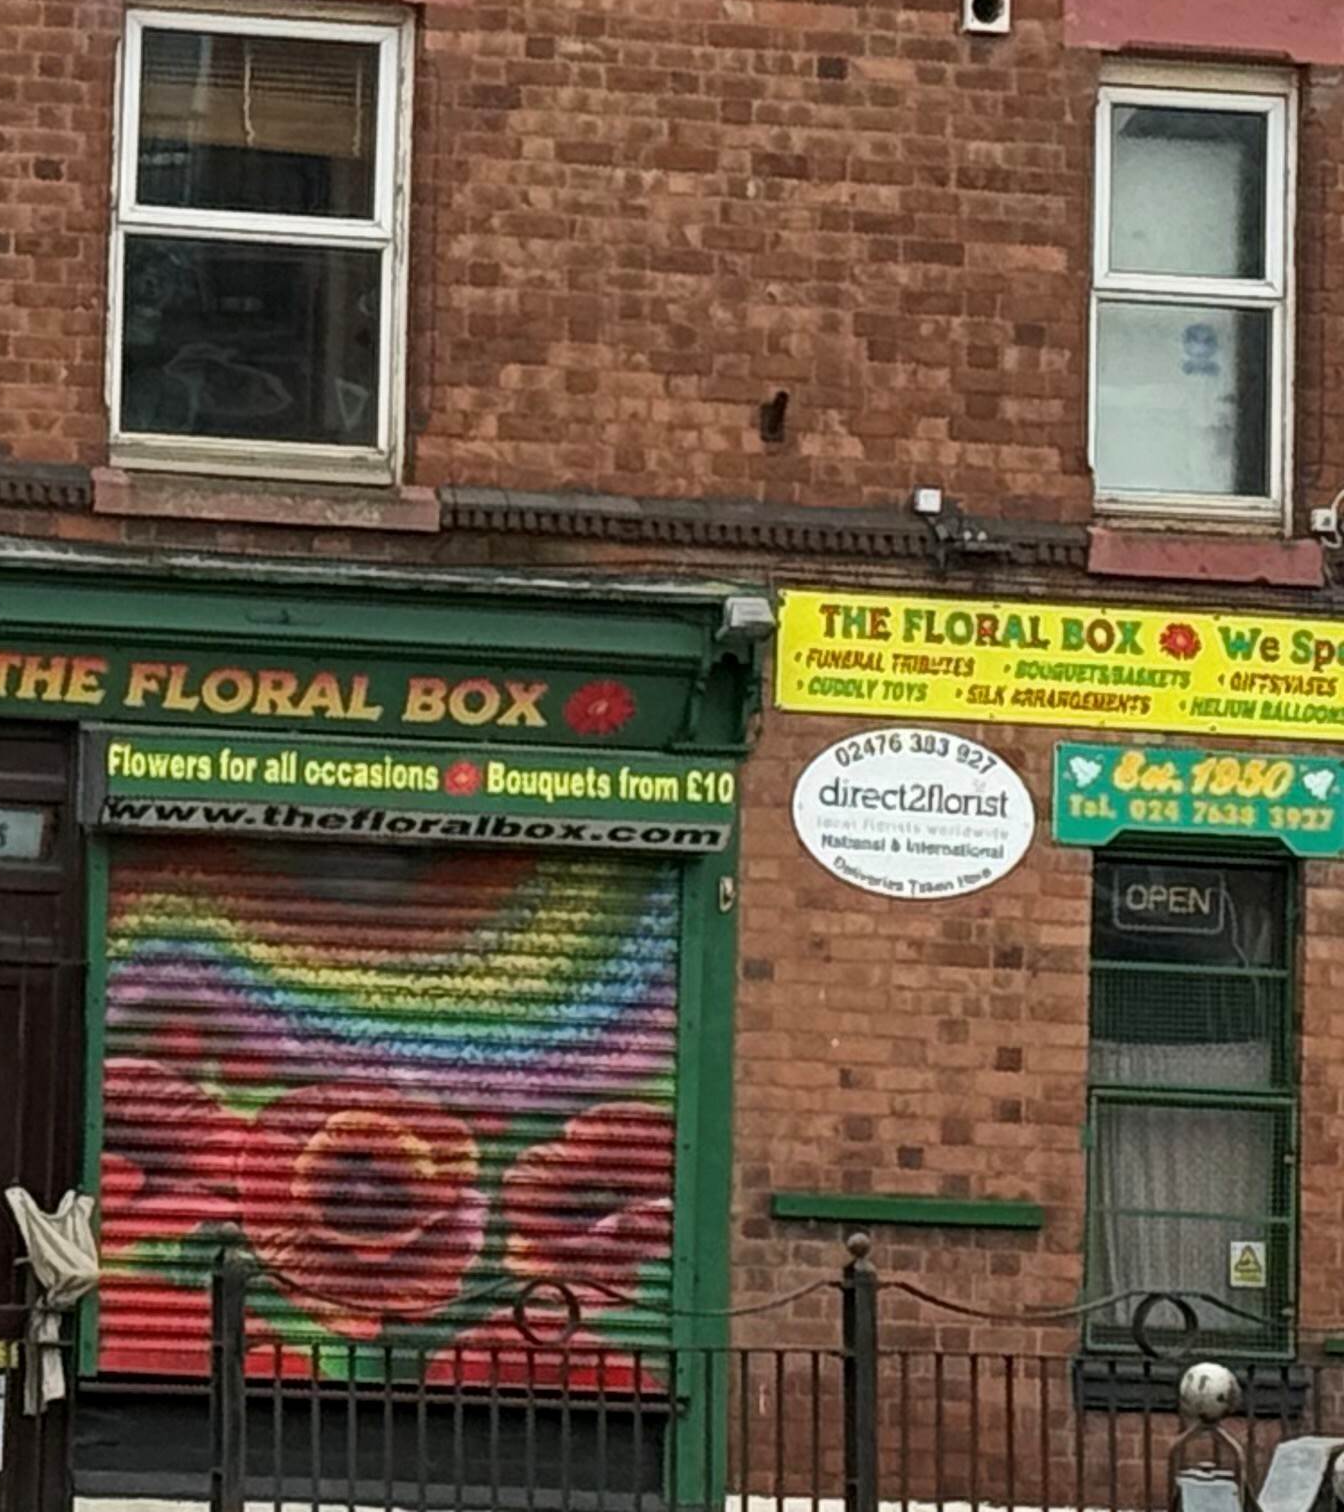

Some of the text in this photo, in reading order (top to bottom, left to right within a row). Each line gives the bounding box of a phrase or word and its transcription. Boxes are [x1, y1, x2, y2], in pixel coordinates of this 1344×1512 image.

[819, 604, 892, 641] THE
[902, 608, 1050, 649] FLORAL
[1061, 618, 1144, 655] BOX
[1218, 626, 1280, 662] We
[806, 648, 885, 673] FUNERAL
[892, 653, 975, 677] TRIBUTES
[123, 662, 383, 720] FLORAL
[402, 678, 548, 727] BOX
[808, 676, 879, 700] CUDDLY
[882, 680, 928, 702] TOYS
[966, 684, 1007, 706] SILK
[1011, 688, 1151, 714] ARRANGEMENTS
[1190, 696, 1257, 719] HELIUM
[108, 743, 735, 803] Flowers for all occasions Bouquets from £10
[835, 733, 997, 774] 02476 383 927
[818, 776, 1009, 818] direct2florist
[1191, 757, 1294, 799] 1950
[105, 797, 723, 847] www.thefloralbox.com
[1069, 794, 1117, 819] Tel.
[1129, 798, 1179, 824] 024
[822, 834, 885, 852] National
[907, 838, 1004, 859] International
[1126, 884, 1211, 915] OPEN
